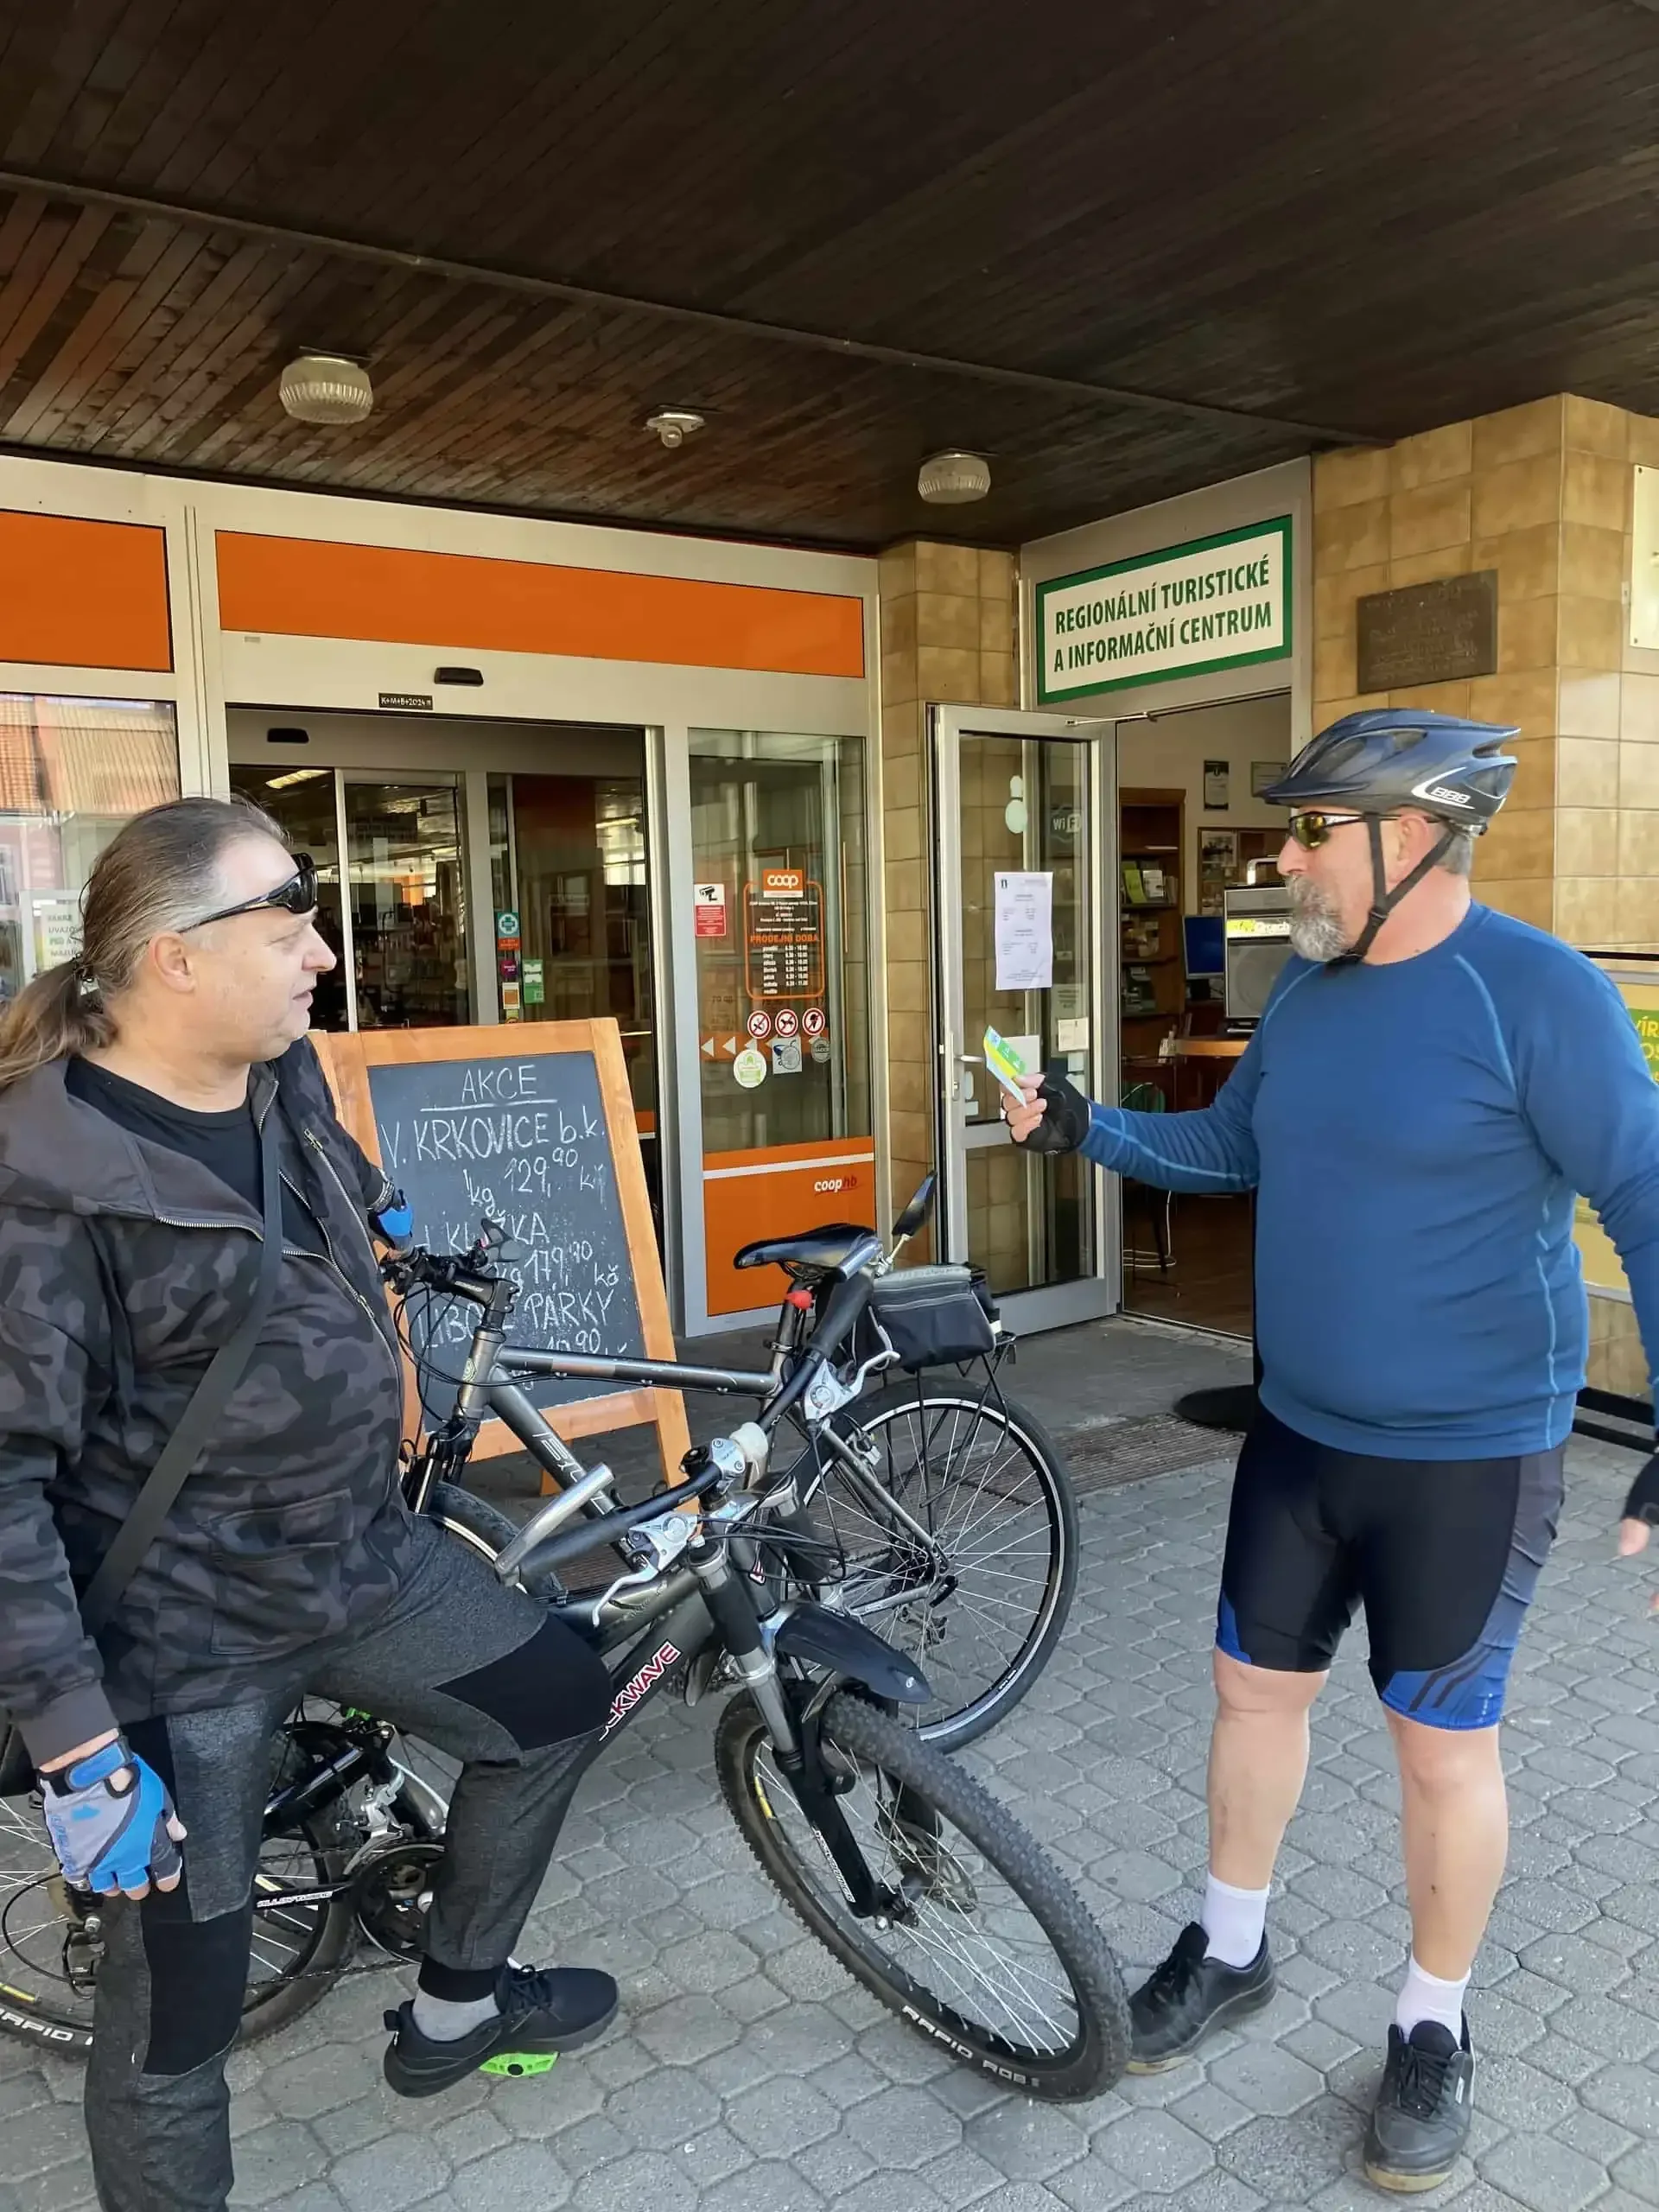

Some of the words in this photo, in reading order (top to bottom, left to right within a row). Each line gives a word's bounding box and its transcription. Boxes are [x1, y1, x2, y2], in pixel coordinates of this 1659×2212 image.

[1055, 582, 1157, 635] REGIONÁLNÍ
[1161, 554, 1270, 610] TURISTICKÉ
[1053, 649, 1065, 672] A
[1068, 618, 1175, 671] INFORMAČNÍ
[1180, 601, 1272, 645] CENTRUM
[767, 874, 798, 888] coop
[461, 1065, 537, 1103] AKCE
[414, 1113, 550, 1160] KRKOVICE
[524, 1282, 615, 1330] PÁRKY
[0, 2007, 73, 2042] APID
[902, 2005, 973, 2059] RAPID
